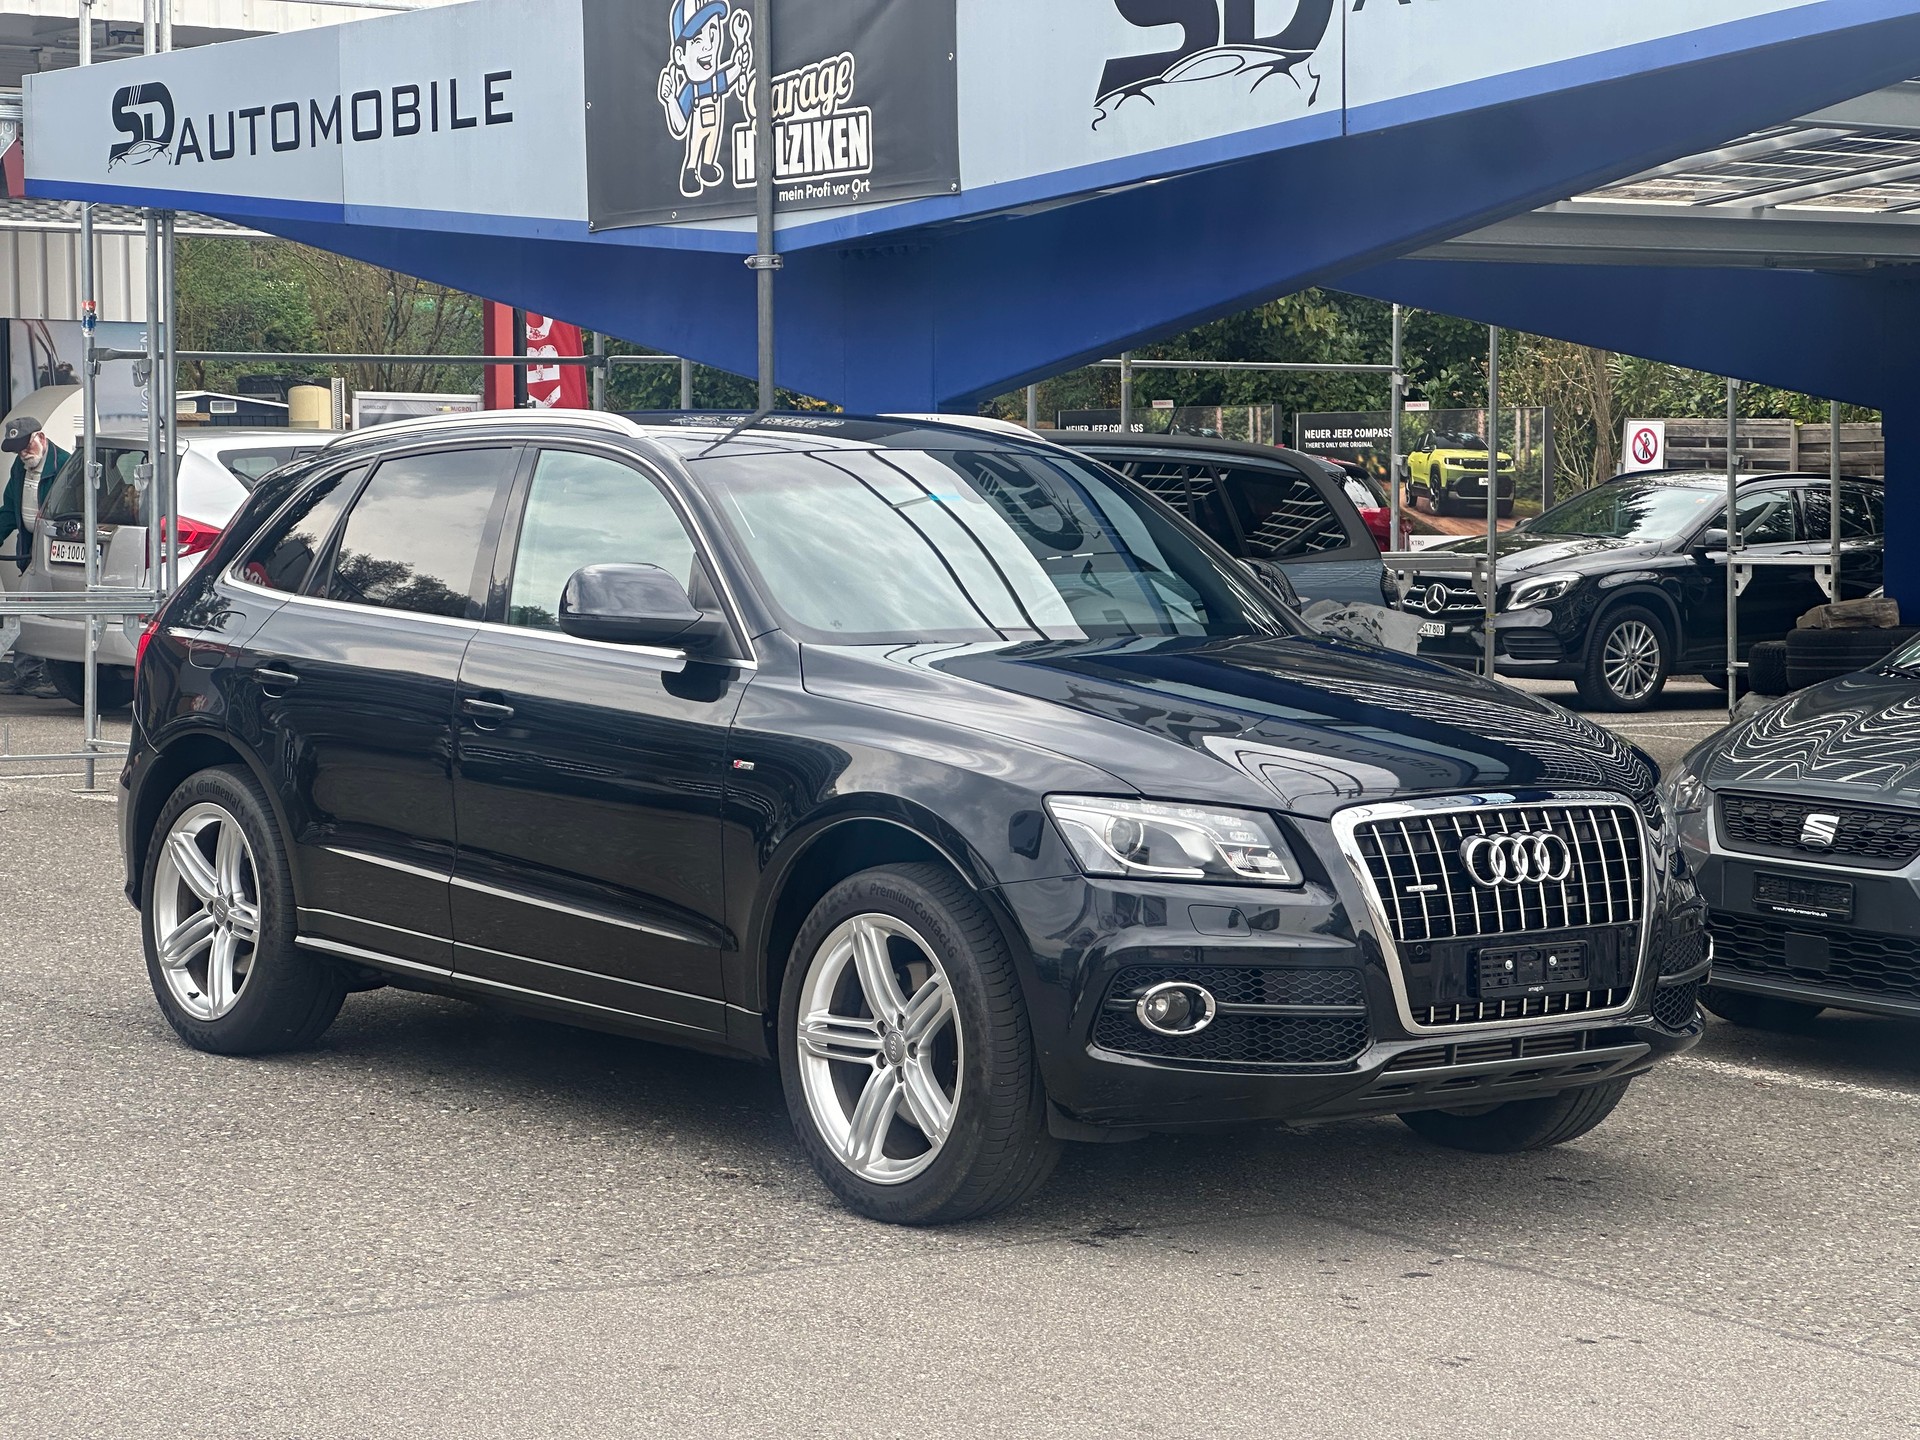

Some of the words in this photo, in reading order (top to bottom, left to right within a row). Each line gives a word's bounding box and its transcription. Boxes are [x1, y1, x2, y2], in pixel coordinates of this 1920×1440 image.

[174, 69, 514, 166] AUTOMOBILE
[736, 115, 868, 181] HLZIKEN
[779, 185, 804, 202] mein
[806, 181, 832, 199] Profi
[833, 183, 850, 196] vor
[851, 178, 871, 195] Ort
[1109, 423, 1144, 433] COASS
[1304, 429, 1331, 439] NEUER
[1354, 427, 1393, 438] COMPASS
[1305, 441, 1325, 449] THERE'S
[196, 780, 241, 811] Continental
